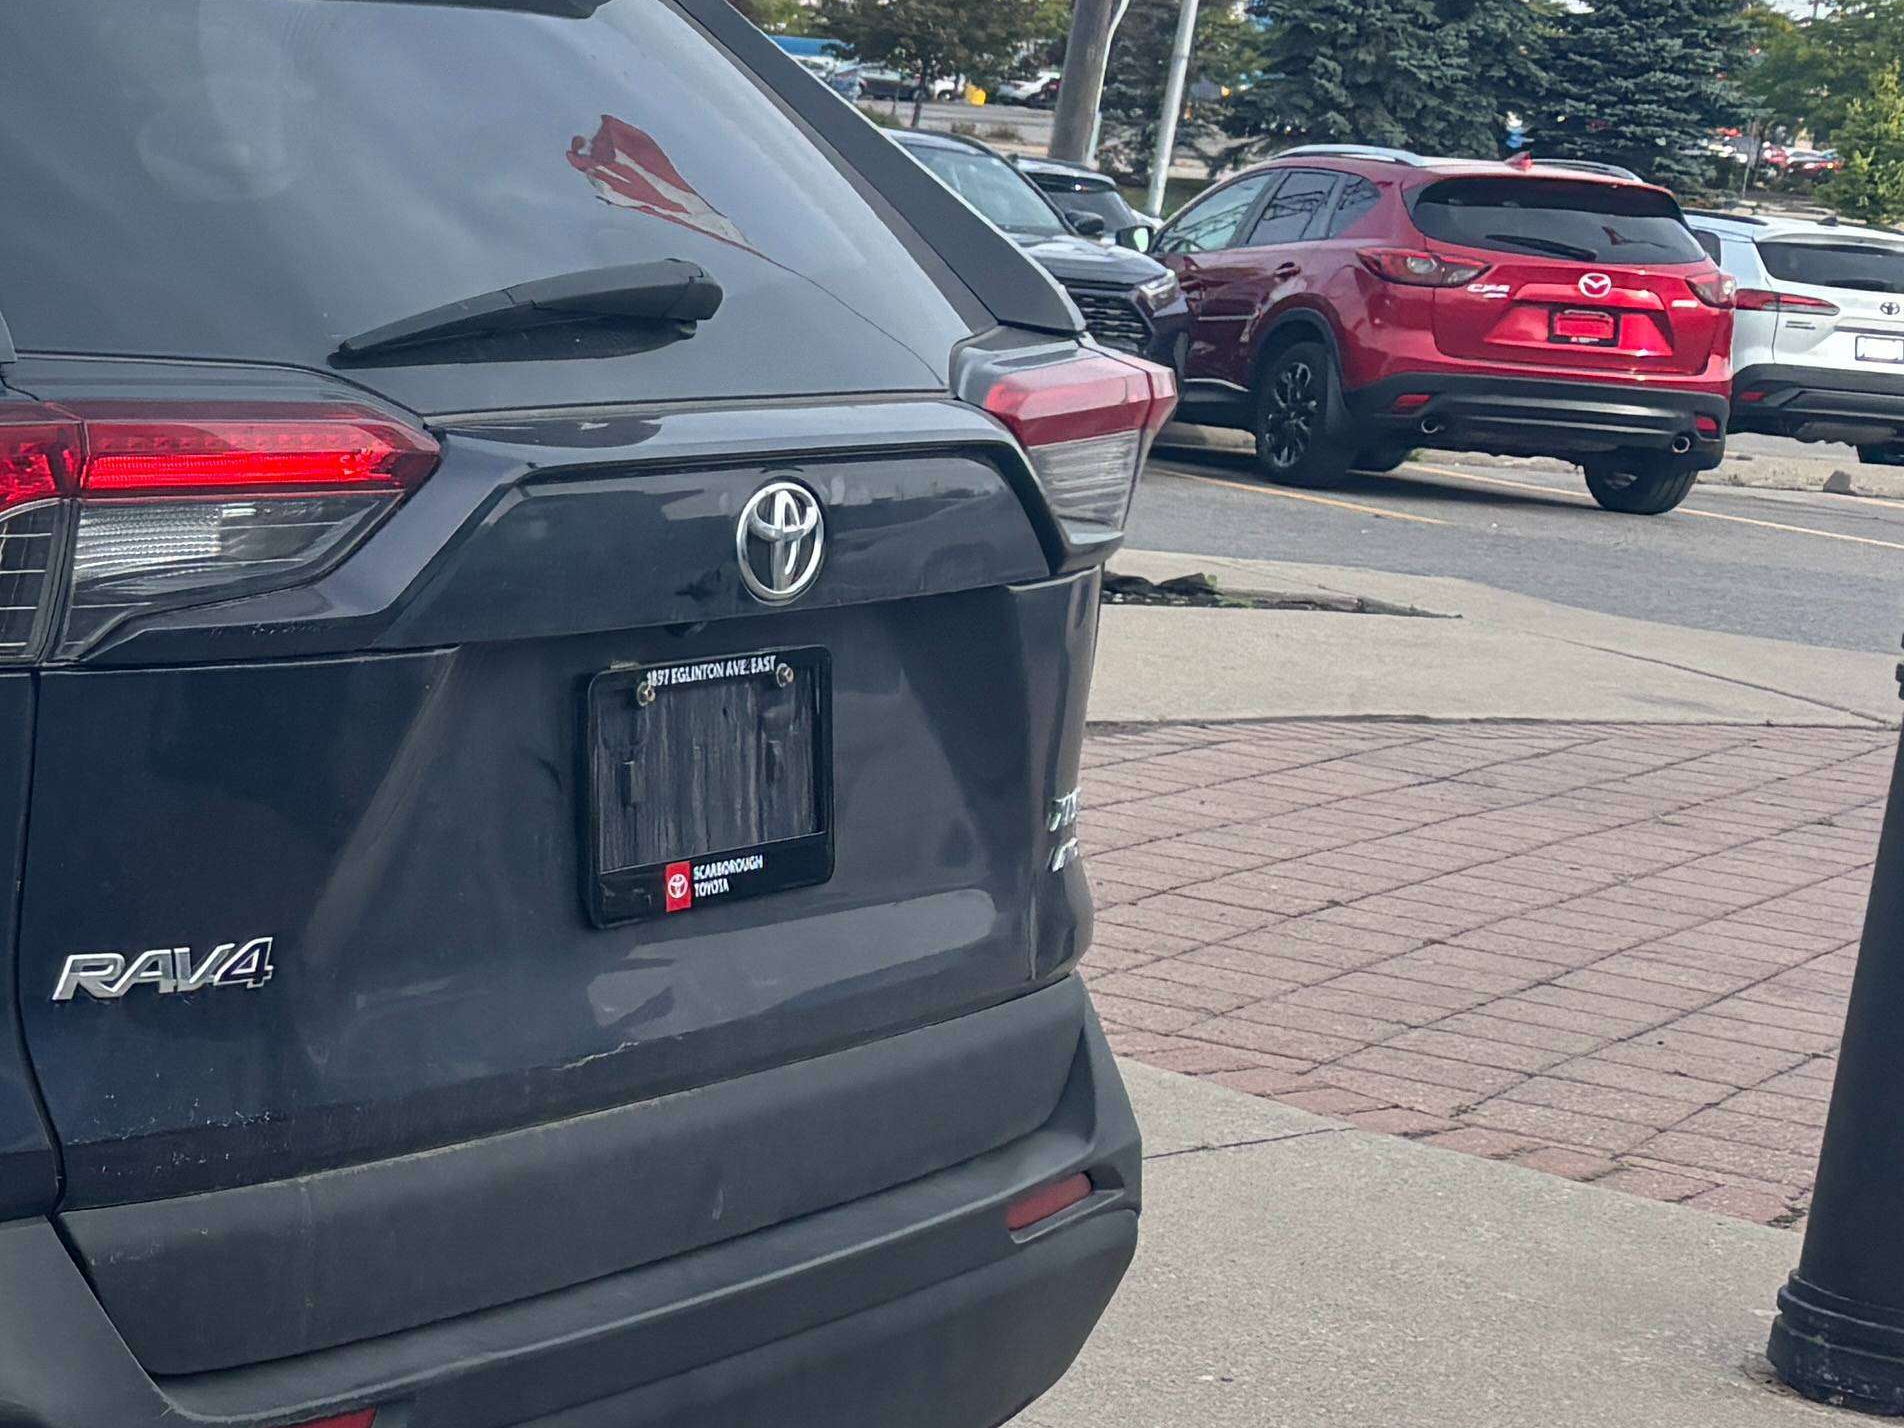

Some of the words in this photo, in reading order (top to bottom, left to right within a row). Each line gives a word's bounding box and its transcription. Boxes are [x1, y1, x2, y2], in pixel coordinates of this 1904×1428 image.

[671, 661, 724, 684] EGLINTON
[750, 655, 777, 674] EAST
[693, 854, 763, 880] SCARBOROUGH
[694, 878, 729, 897] TOYOTA
[52, 936, 274, 1000] RAV4
